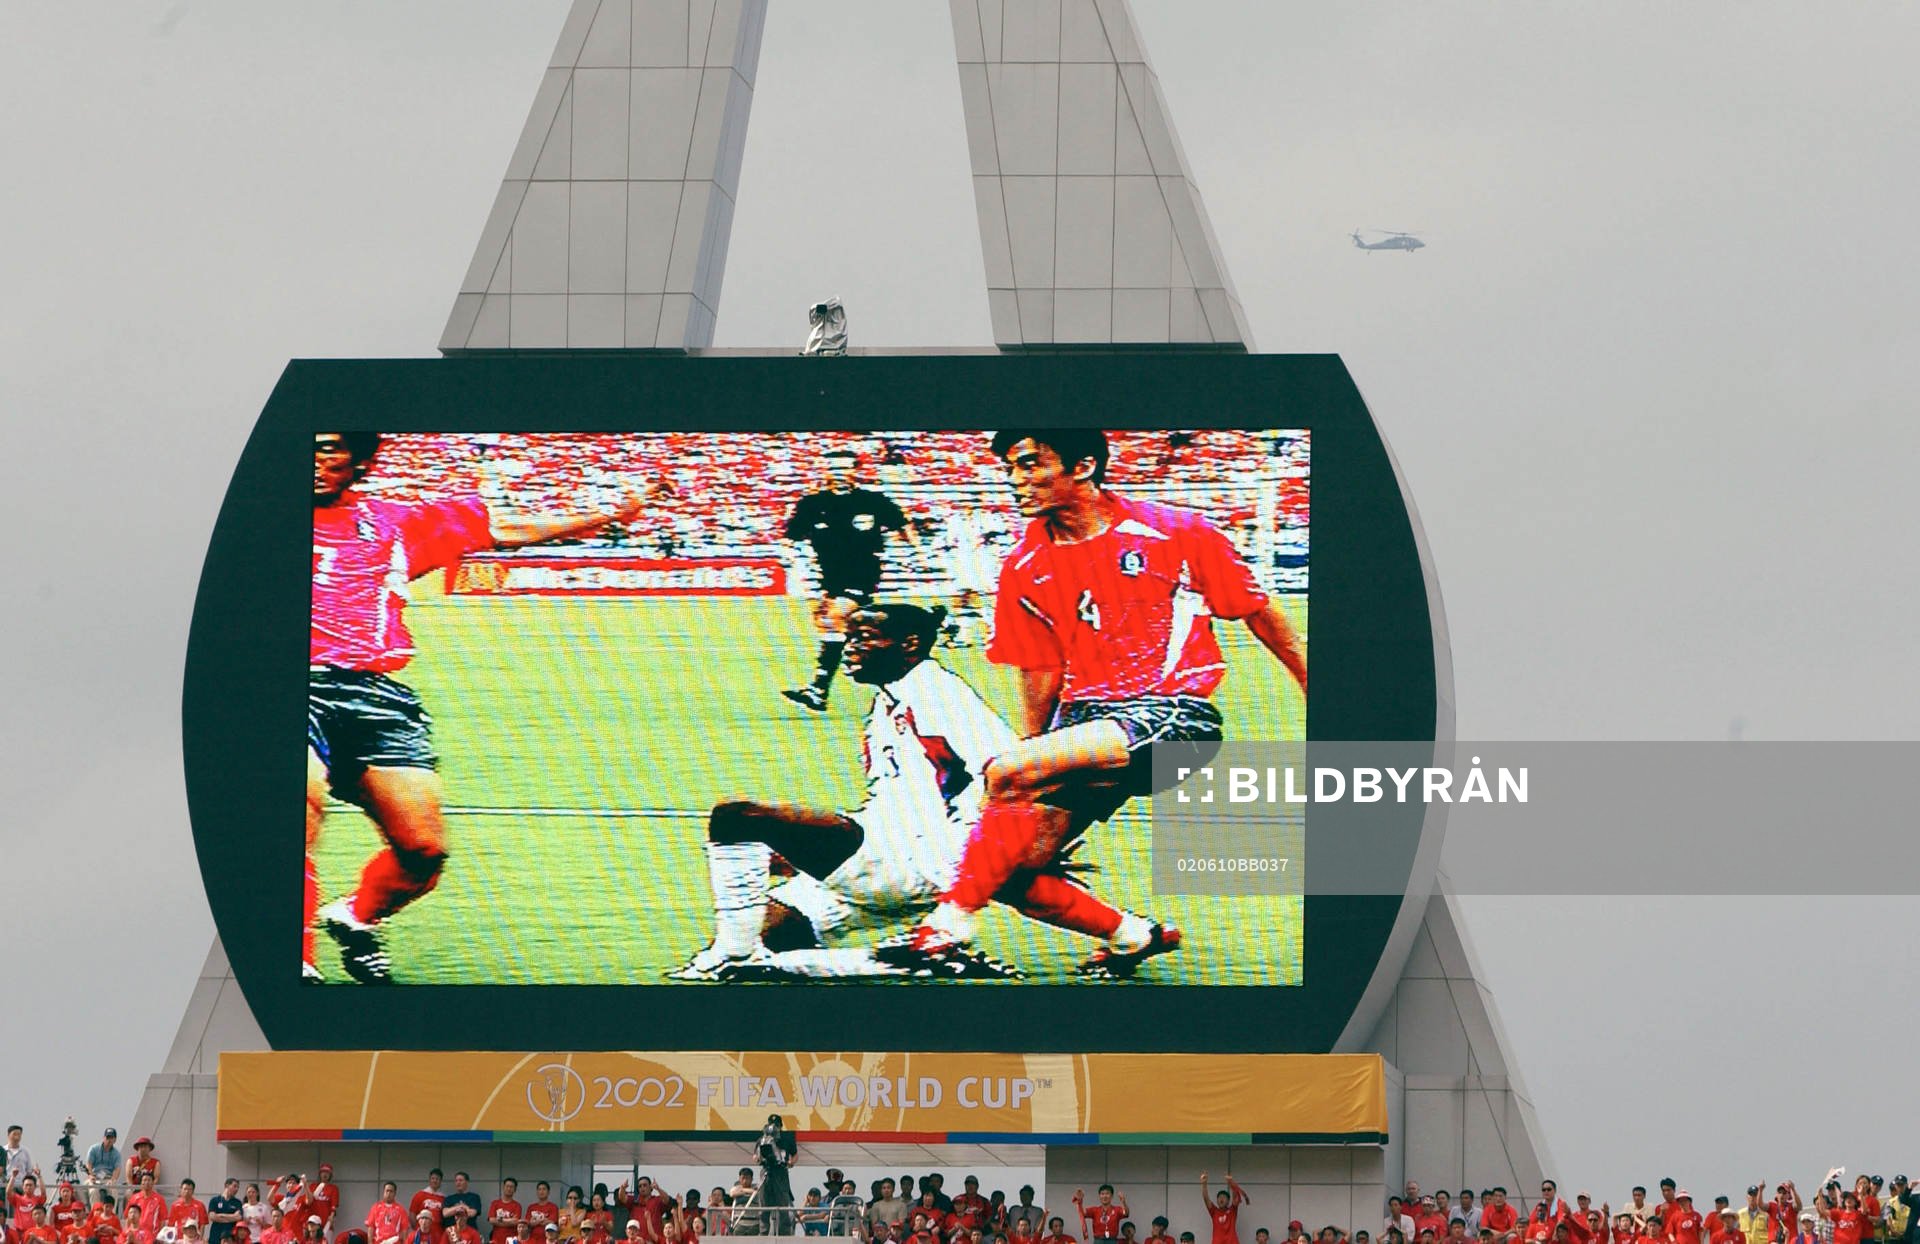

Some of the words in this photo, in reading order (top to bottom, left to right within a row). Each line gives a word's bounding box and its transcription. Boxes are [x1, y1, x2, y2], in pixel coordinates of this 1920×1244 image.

[1078, 589, 1101, 631] 4
[593, 1076, 684, 1109] 2002
[698, 1076, 786, 1109] FIFA
[801, 1077, 943, 1109] WORLD
